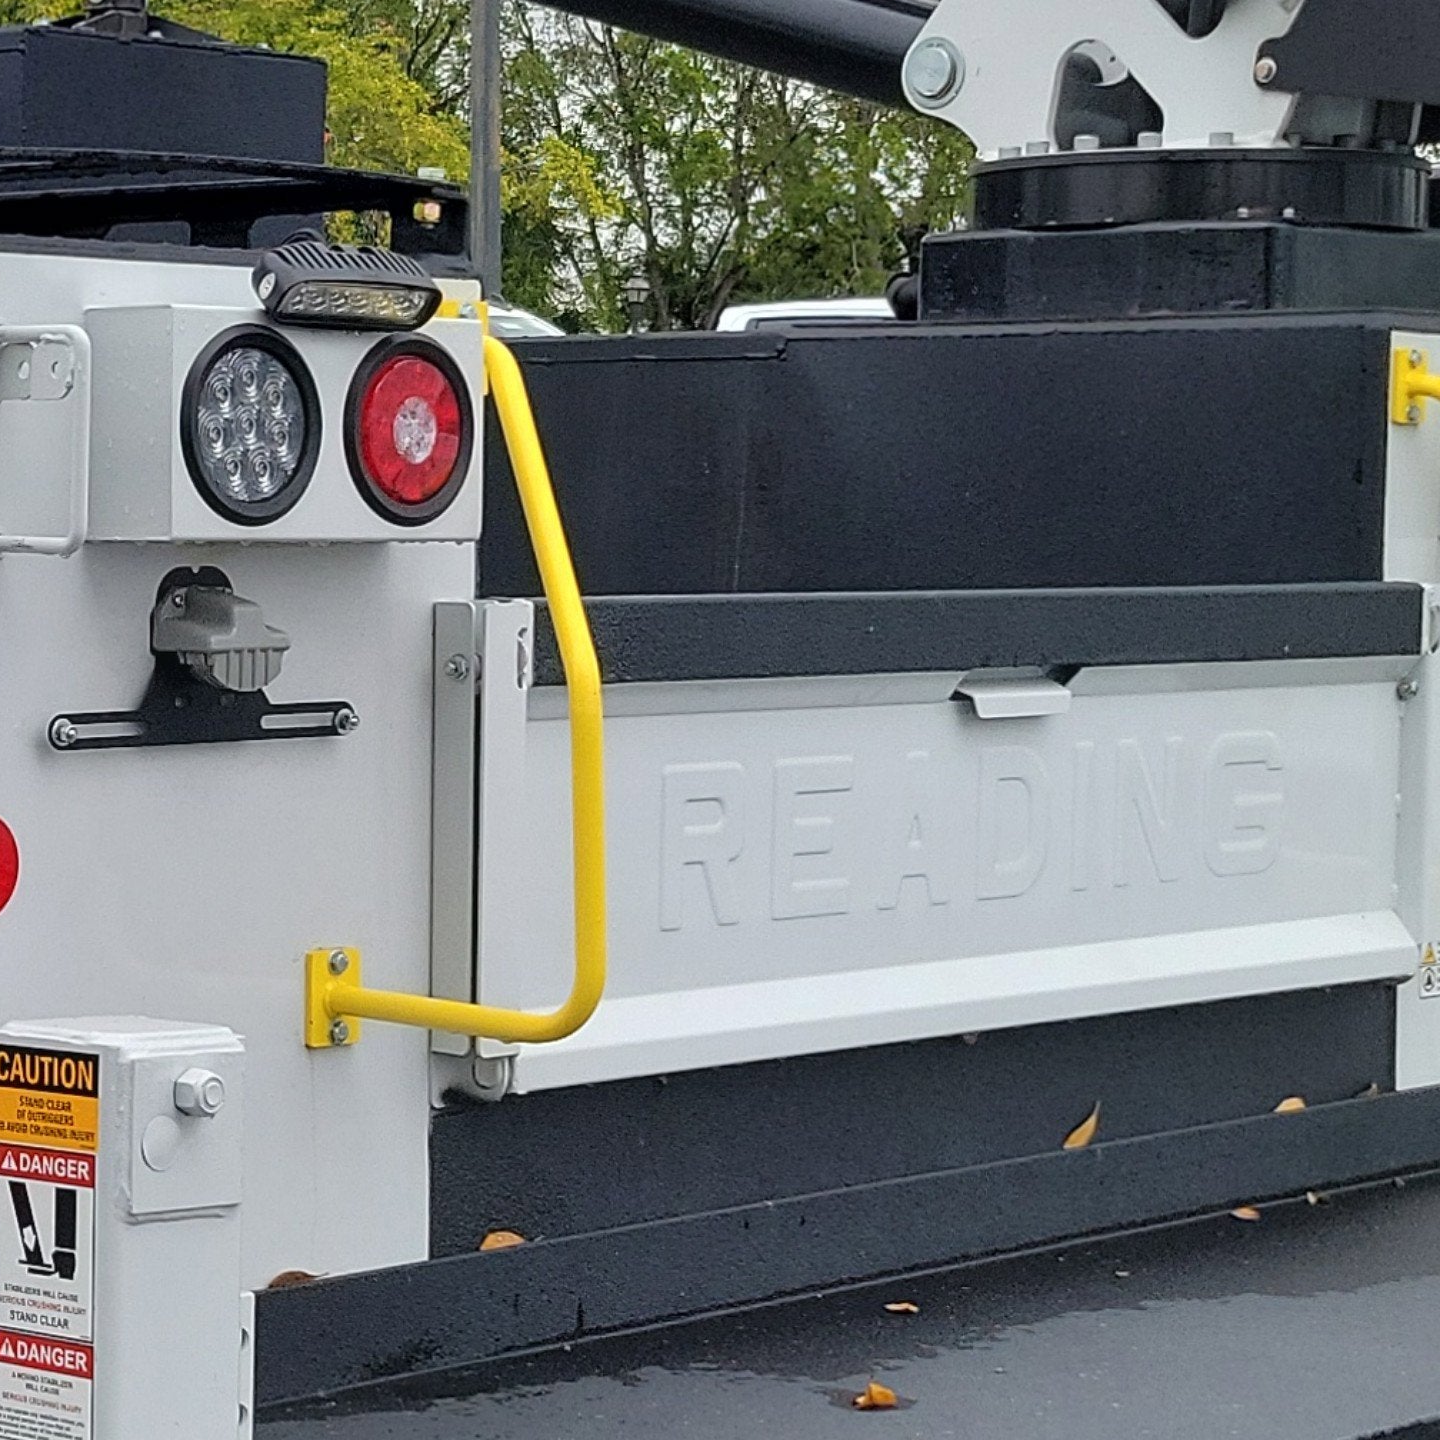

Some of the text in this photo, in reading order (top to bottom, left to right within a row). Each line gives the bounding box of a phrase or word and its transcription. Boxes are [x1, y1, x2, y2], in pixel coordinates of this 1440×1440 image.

[658, 730, 1284, 932] READING
[19, 1095, 72, 1112] STAND CLEAR
[19, 1152, 90, 1181] DANGER
[9, 1309, 69, 1330] STAND CLEAR
[16, 1340, 88, 1373] DANGER
